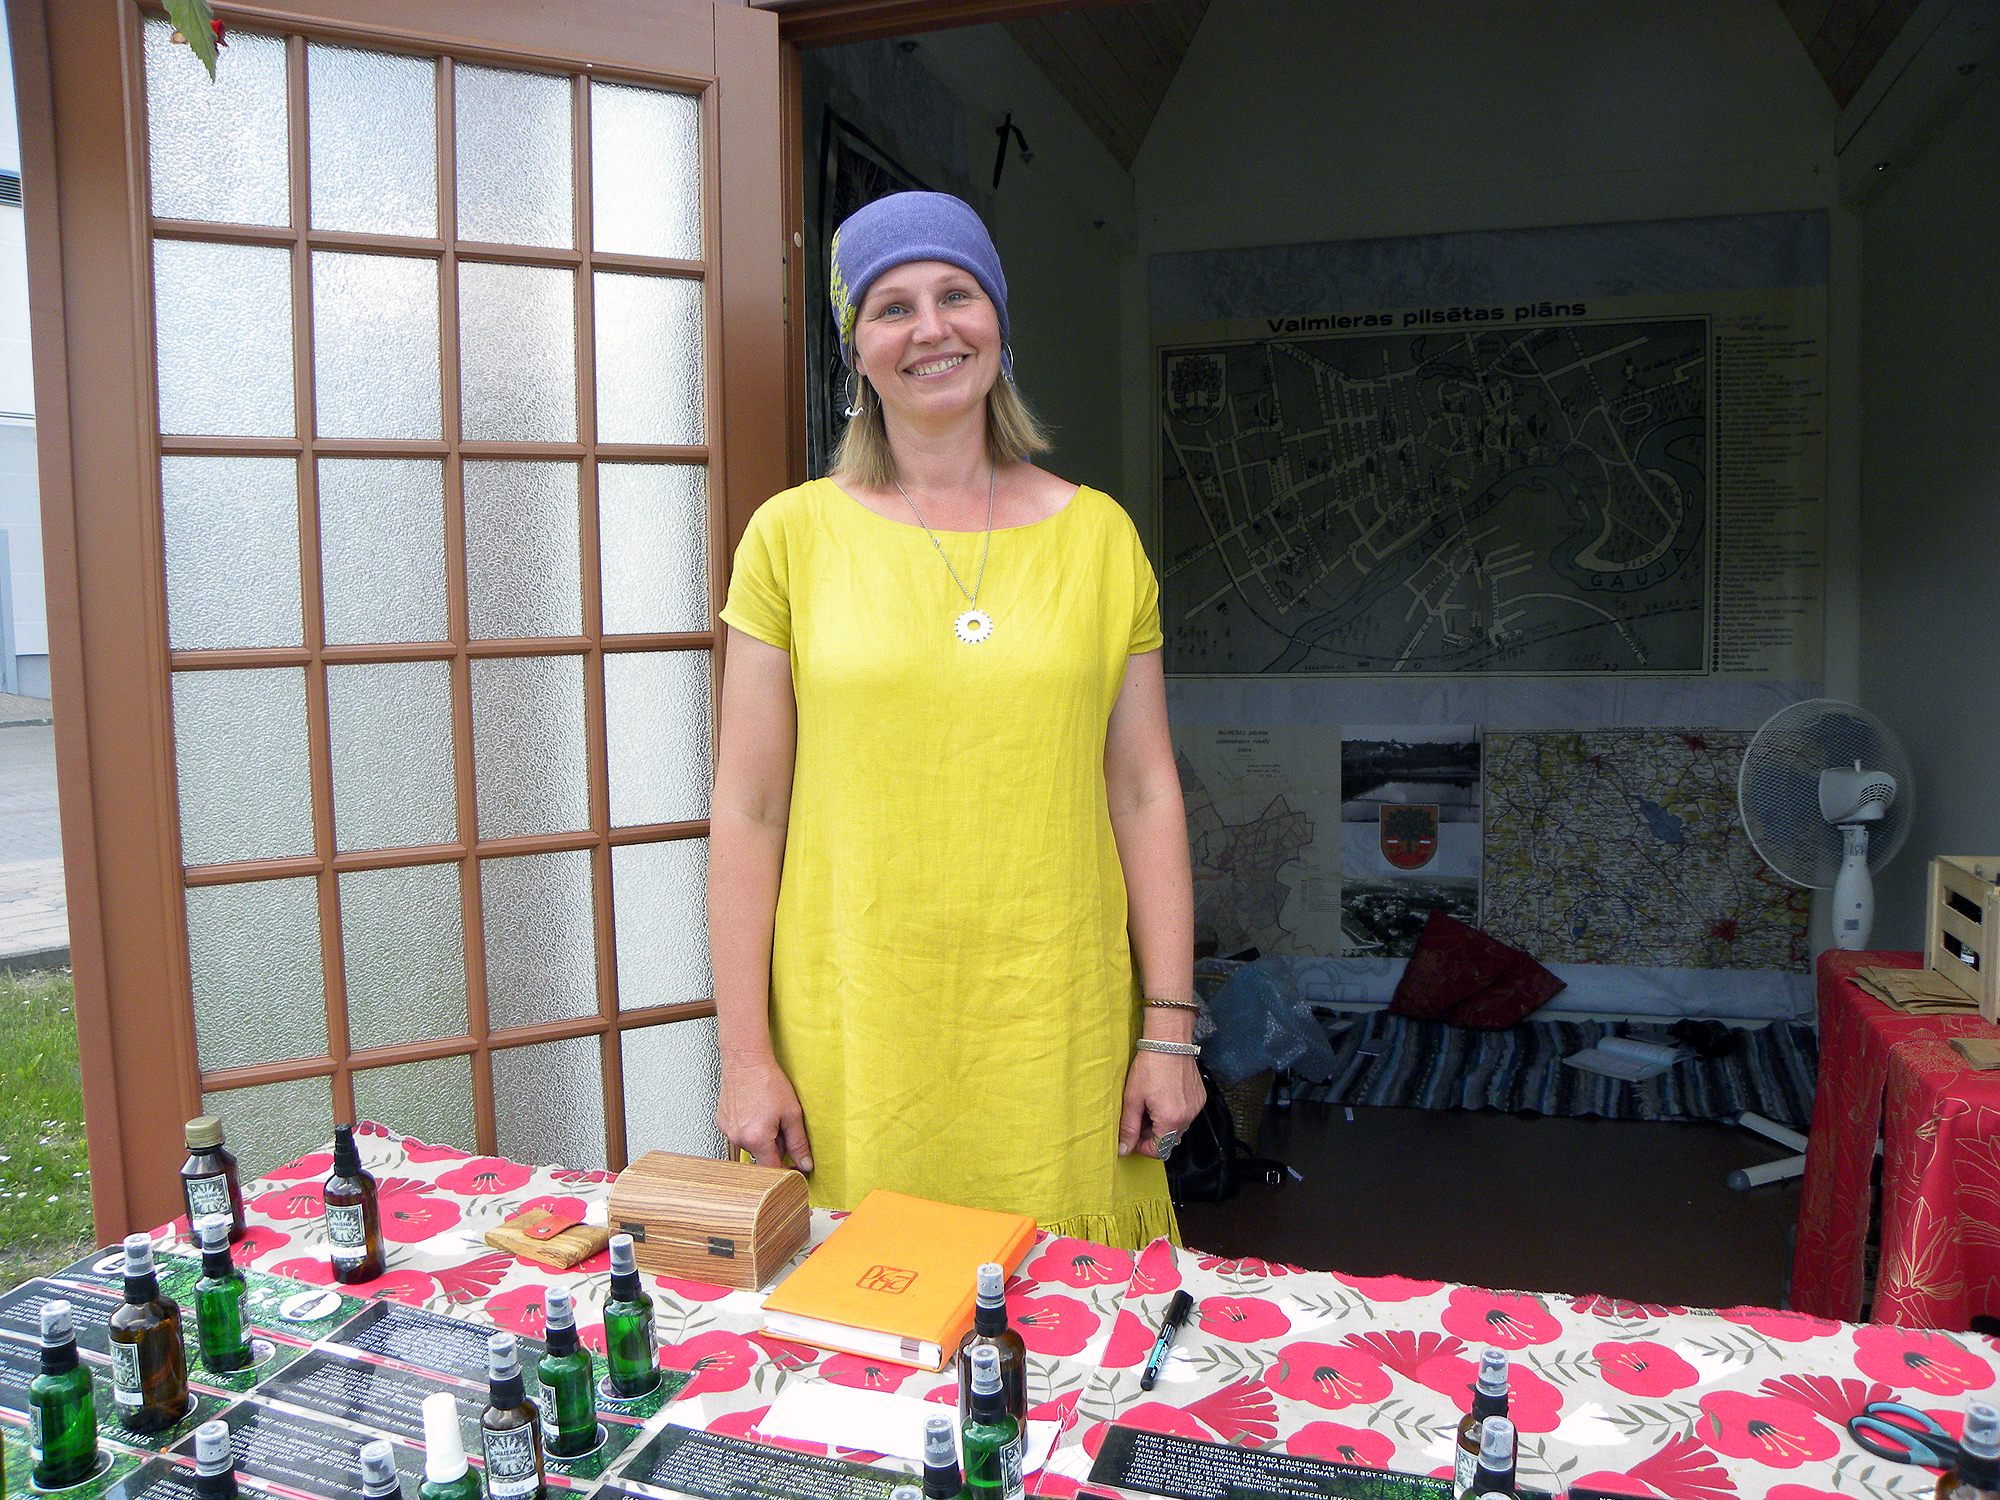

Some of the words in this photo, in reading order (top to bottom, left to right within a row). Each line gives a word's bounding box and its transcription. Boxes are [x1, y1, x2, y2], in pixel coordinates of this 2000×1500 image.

[1267, 310, 1393, 333] Valmieras
[1402, 305, 1504, 327] pilsētas
[1514, 302, 1586, 321] plāns
[1590, 546, 1688, 590] GAUJA
[594, 1401, 632, 1414] ONIJA
[796, 1453, 809, 1461] UN
[1134, 1439, 1164, 1449] PALĪDZ
[1165, 1445, 1193, 1454] ATGŪT
[1302, 1468, 1337, 1478] DOMAS.
[1137, 1433, 1165, 1443] PIEMĪT
[1166, 1438, 1197, 1448] SAULES
[1242, 1451, 1279, 1462] IZSTARO
